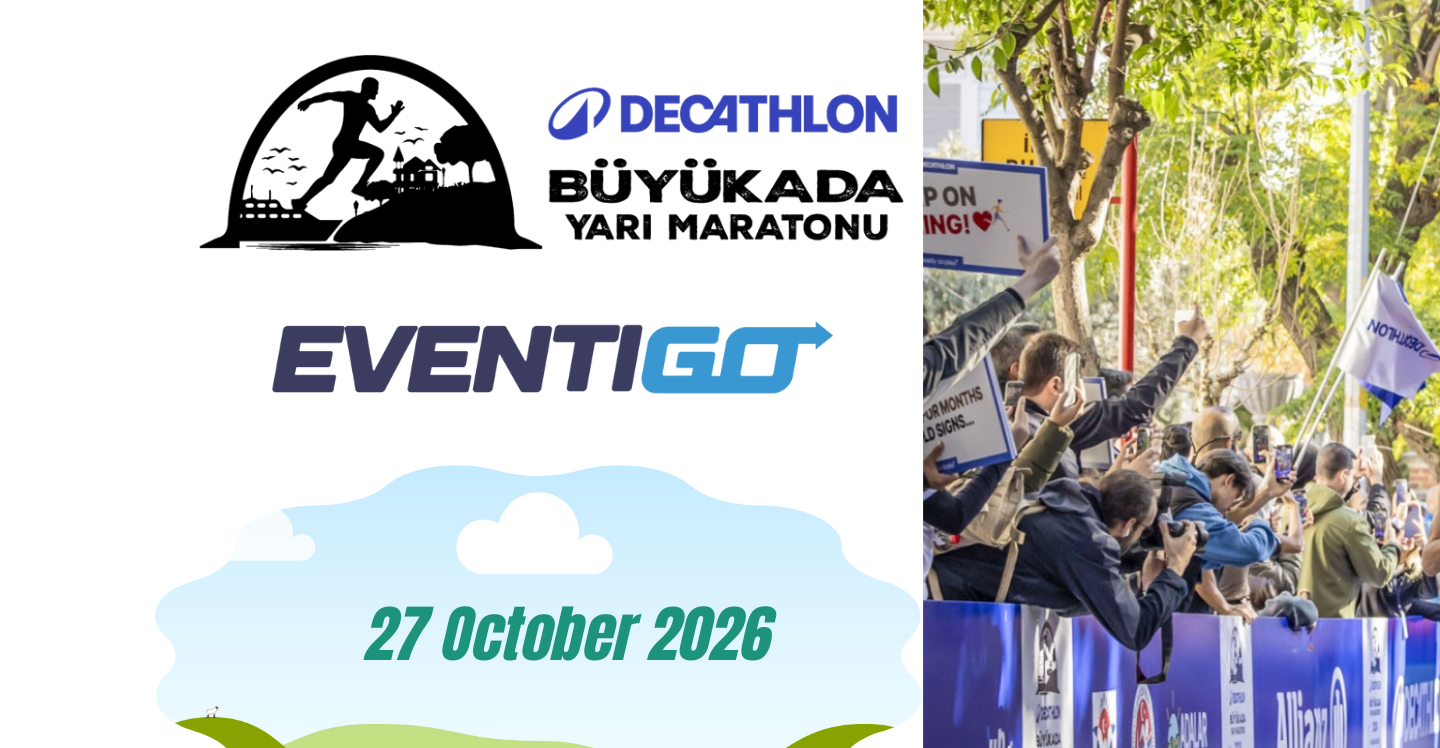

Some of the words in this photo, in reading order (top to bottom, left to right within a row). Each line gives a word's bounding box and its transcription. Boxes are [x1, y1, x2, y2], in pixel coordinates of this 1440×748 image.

[923, 186, 938, 207] P
[942, 186, 976, 206] ON
[923, 214, 970, 235] ING!
[939, 386, 983, 415] MONTHS
